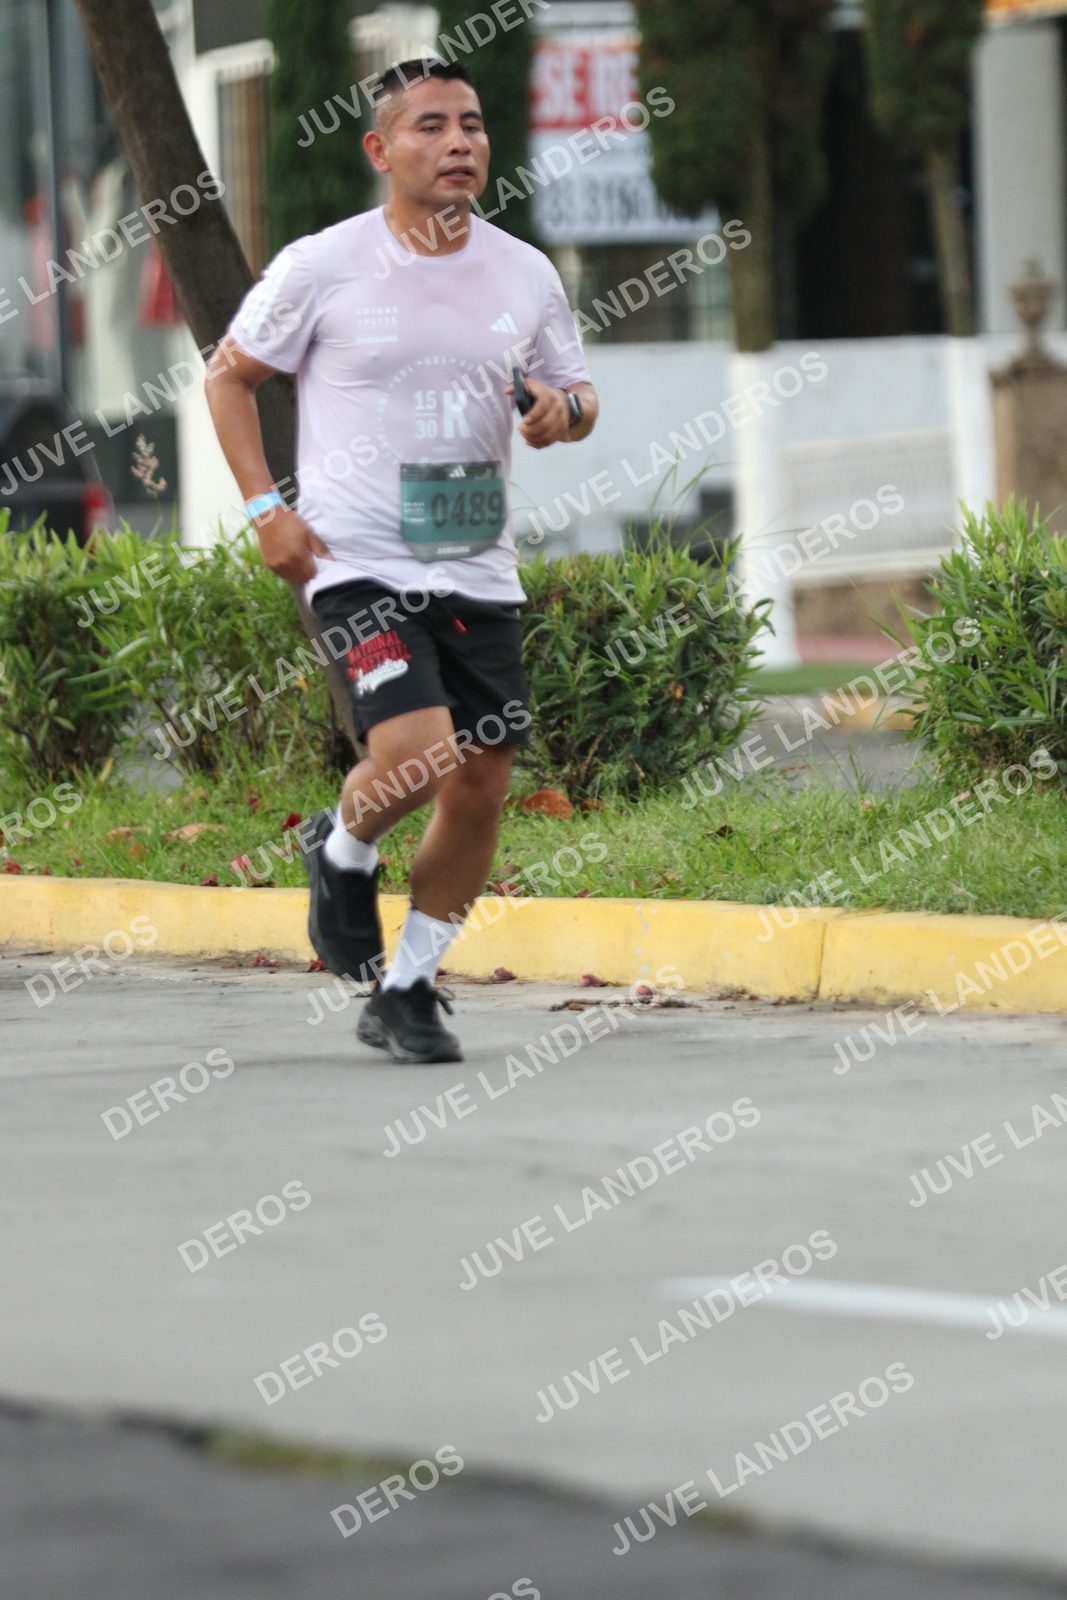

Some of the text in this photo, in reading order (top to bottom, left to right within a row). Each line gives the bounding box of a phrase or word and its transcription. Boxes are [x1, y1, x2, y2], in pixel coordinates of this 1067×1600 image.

[414, 390, 437, 410] 15
[415, 419, 438, 439] 30
[431, 491, 503, 528] 0489
